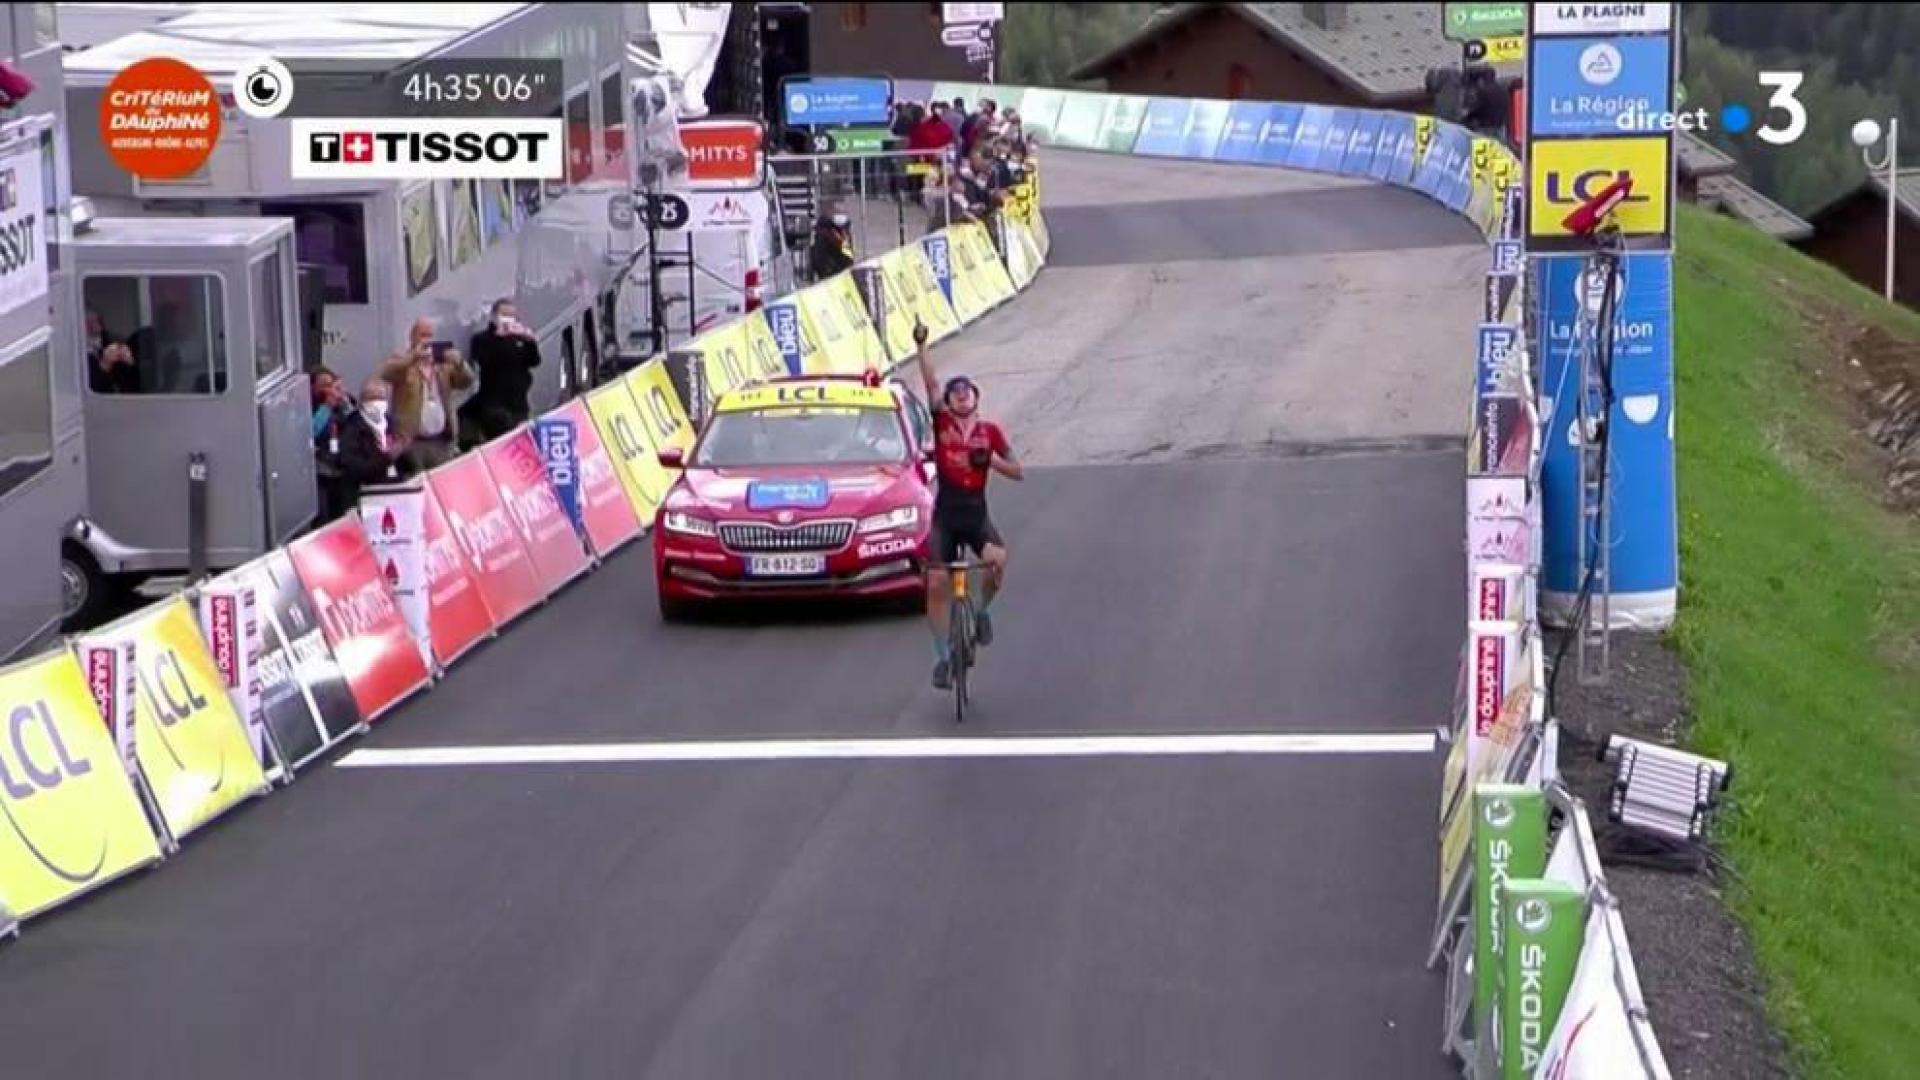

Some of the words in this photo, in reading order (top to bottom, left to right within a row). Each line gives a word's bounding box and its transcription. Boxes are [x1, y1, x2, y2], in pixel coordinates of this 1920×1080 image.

[1558, 5, 1577, 18] LA
[1550, 98, 1571, 113] La
[778, 385, 833, 401] LCL
